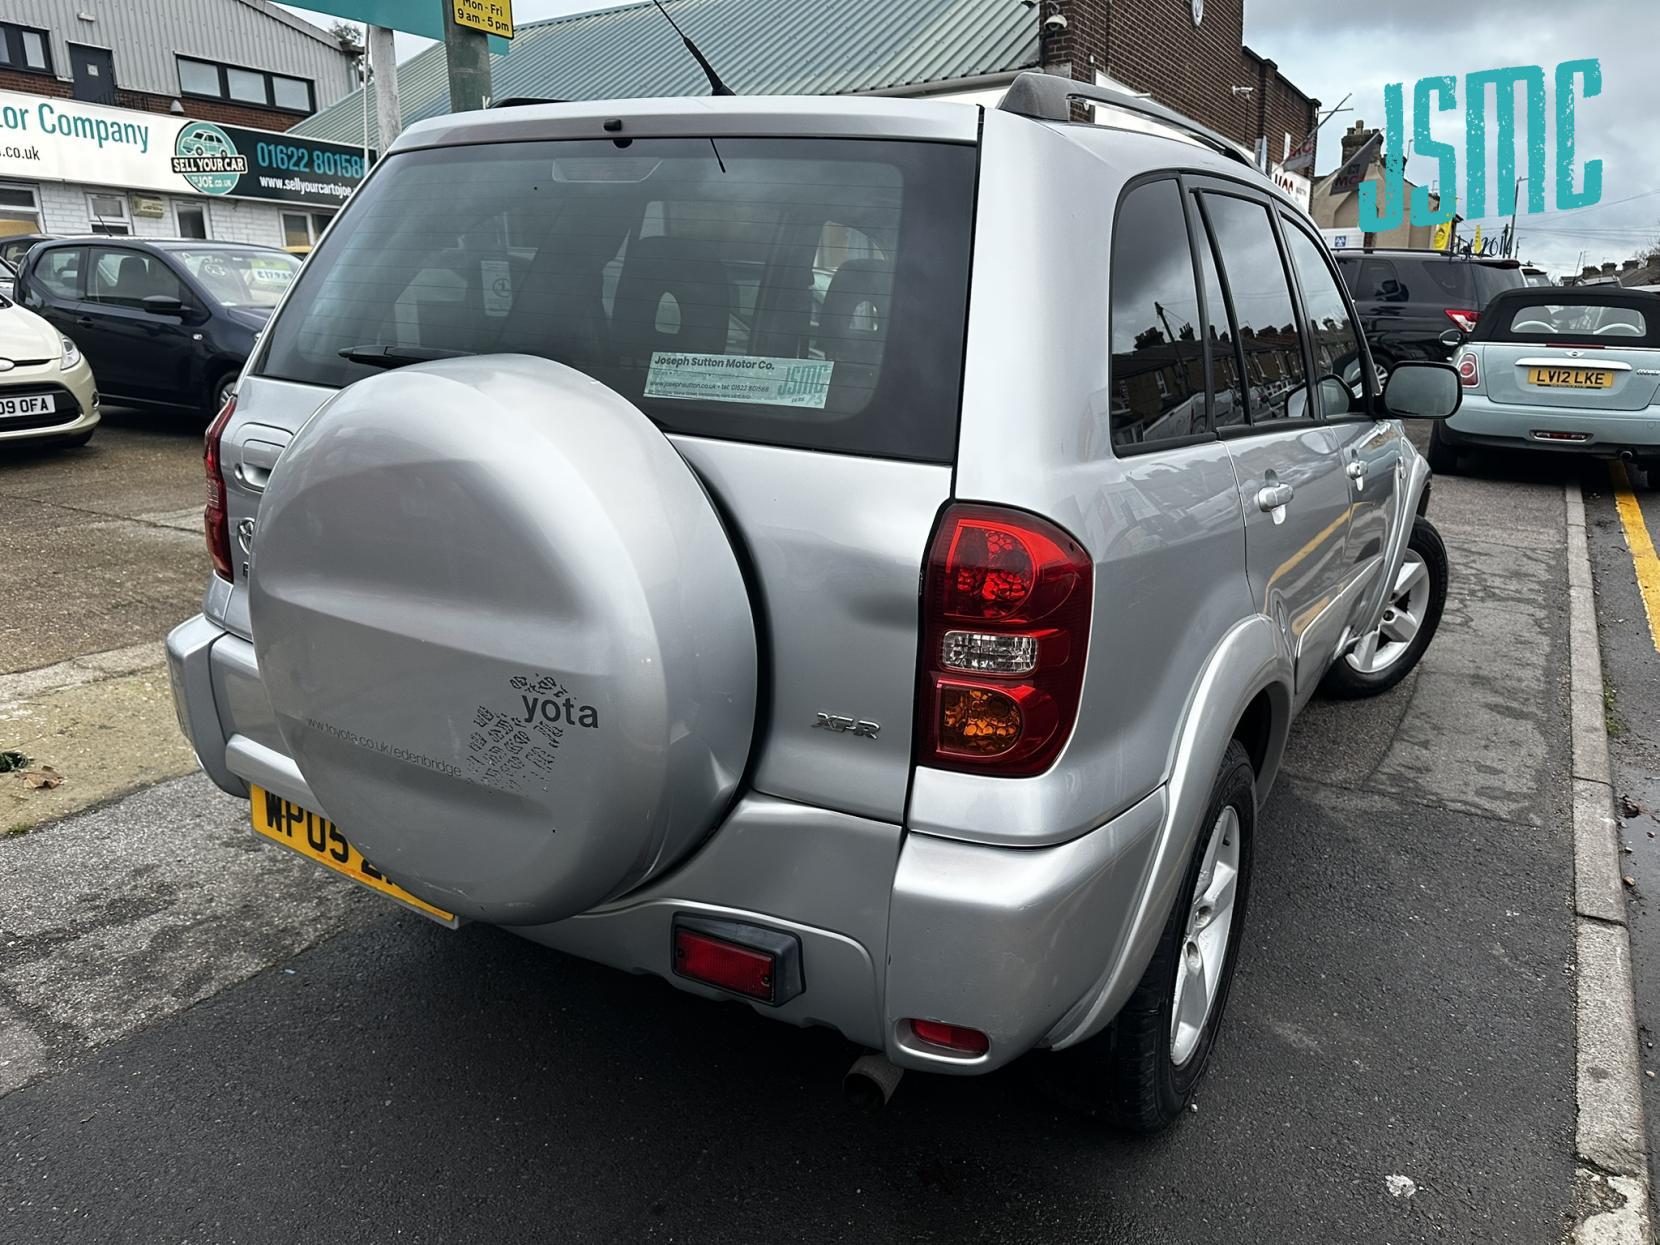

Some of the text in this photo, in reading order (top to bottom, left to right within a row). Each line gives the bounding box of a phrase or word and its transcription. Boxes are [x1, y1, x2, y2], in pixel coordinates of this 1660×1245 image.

[491, 4, 503, 17] Fri
[458, 8, 464, 19] 9
[466, 13, 480, 24] am
[488, 16, 494, 27] 5
[495, 21, 510, 31] pm
[0, 103, 148, 153] or Company
[0, 146, 40, 161] .co.uk
[257, 142, 310, 172] 01622
[173, 158, 244, 171] SELL YOUR CAR
[655, 356, 775, 370] Joseph Sutton Motor Co.
[1537, 369, 1606, 385] LV12 LKE
[20, 397, 49, 413] OFA
[522, 695, 599, 728] yota
